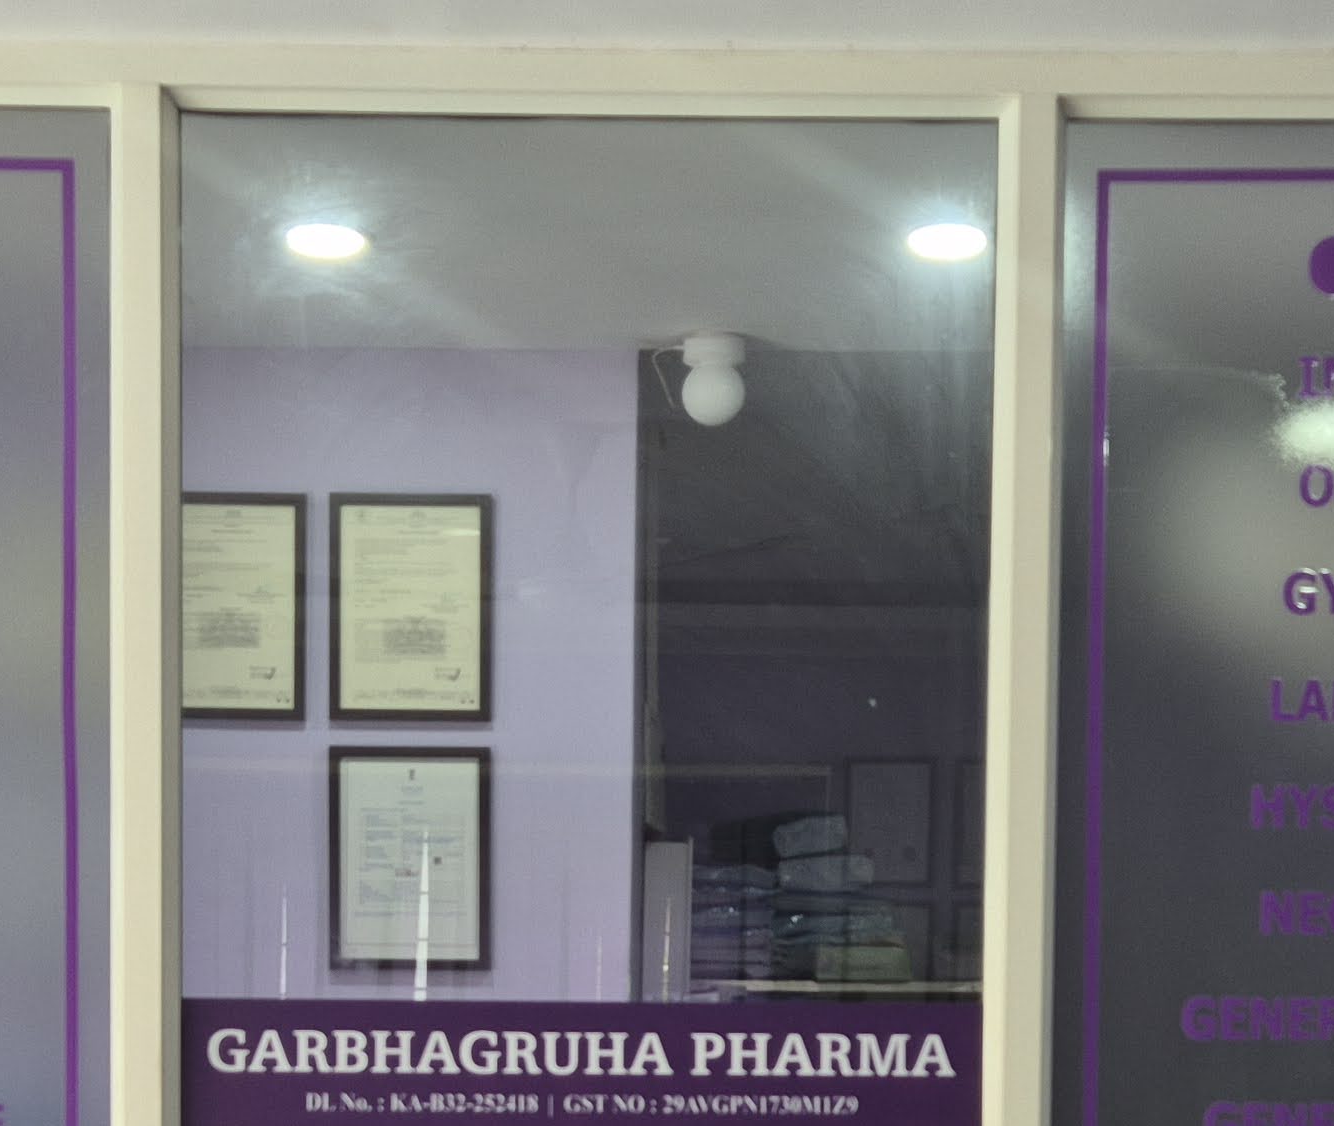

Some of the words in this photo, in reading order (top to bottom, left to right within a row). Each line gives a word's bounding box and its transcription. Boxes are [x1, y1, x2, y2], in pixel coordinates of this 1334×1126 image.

[207, 1028, 674, 1077] GARBHAGRUHA
[690, 1032, 956, 1079] PHARMA
[305, 1092, 336, 1113] DL
[341, 1092, 374, 1113] No.
[390, 1092, 541, 1114] KA-B32-252418
[562, 1093, 607, 1114] GST
[612, 1094, 646, 1114] NO
